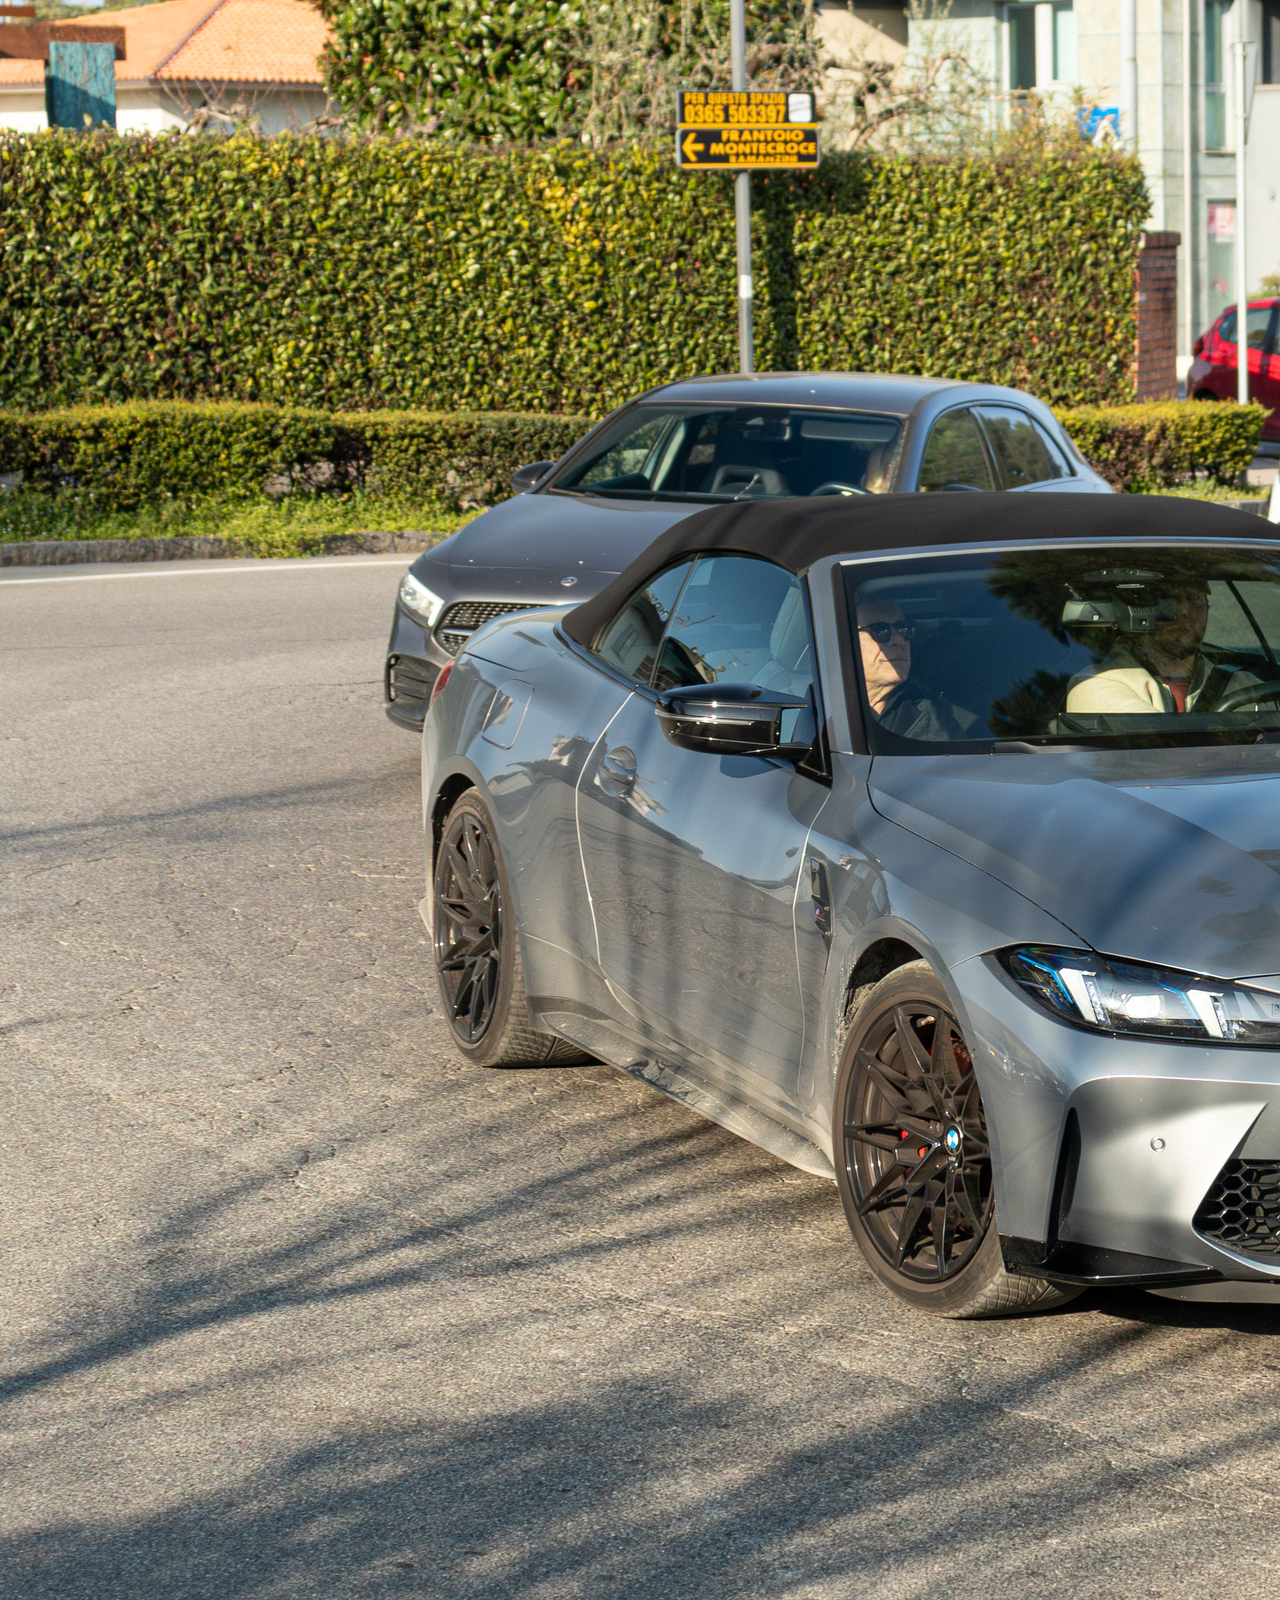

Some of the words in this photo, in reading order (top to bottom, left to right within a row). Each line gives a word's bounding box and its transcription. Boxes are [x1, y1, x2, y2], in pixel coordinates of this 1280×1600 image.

[684, 92, 706, 105] PER
[707, 92, 748, 105] QUESTO
[749, 92, 786, 105] SPAZIO
[684, 104, 725, 123] 0365
[728, 104, 786, 123] 503397
[721, 130, 805, 142] FRANTOIO
[710, 142, 817, 155] MONTECROCE
